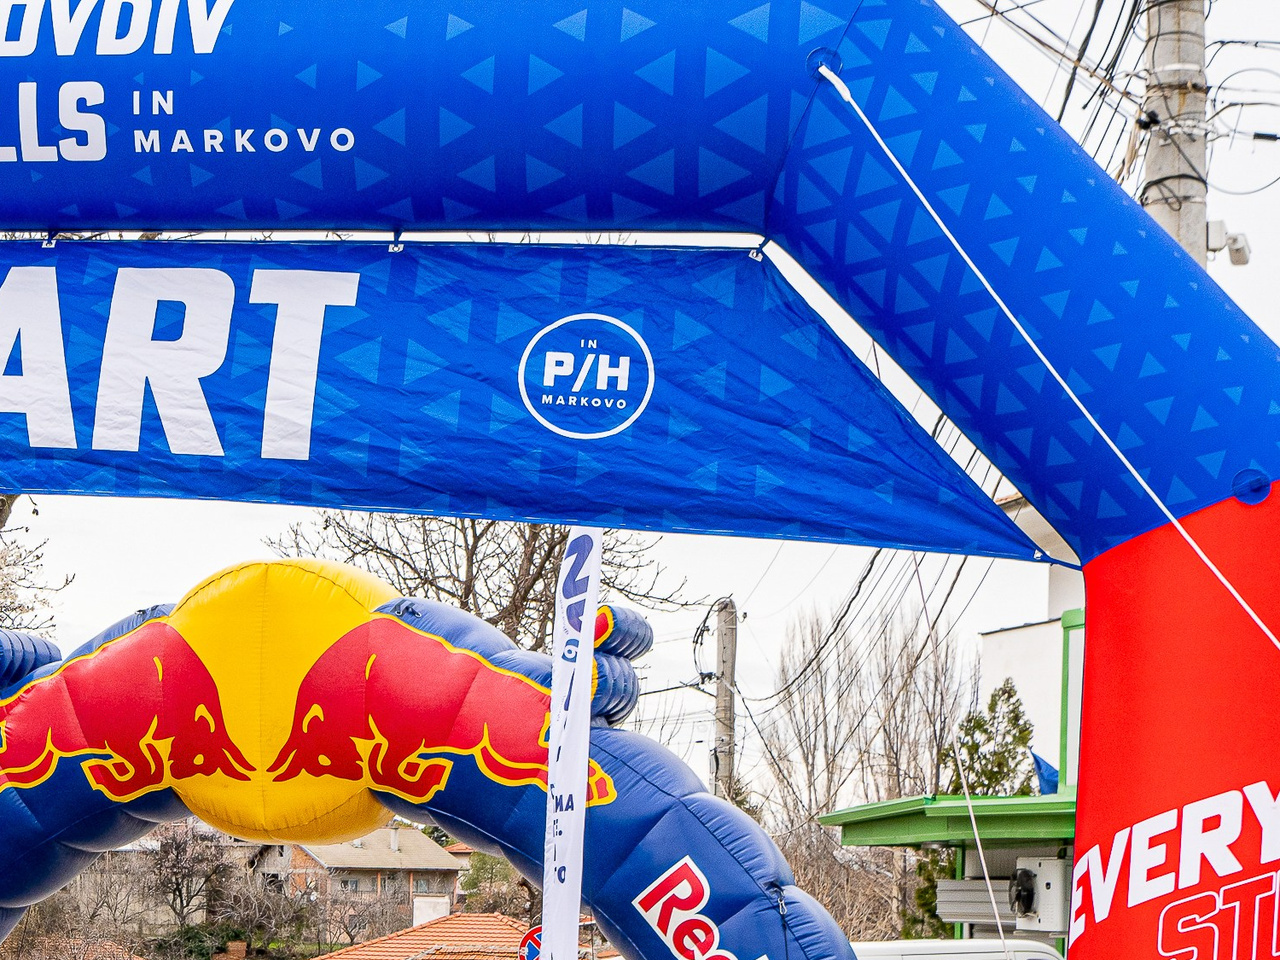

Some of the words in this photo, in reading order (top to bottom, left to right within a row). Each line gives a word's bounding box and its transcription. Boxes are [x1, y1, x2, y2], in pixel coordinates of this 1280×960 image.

[132, 90, 174, 116] IN
[133, 127, 356, 154] MARKOVO
[580, 339, 598, 349] IN
[543, 350, 631, 393] P/H
[541, 394, 627, 410] MARKOVO
[1068, 780, 1280, 950] EVERY
